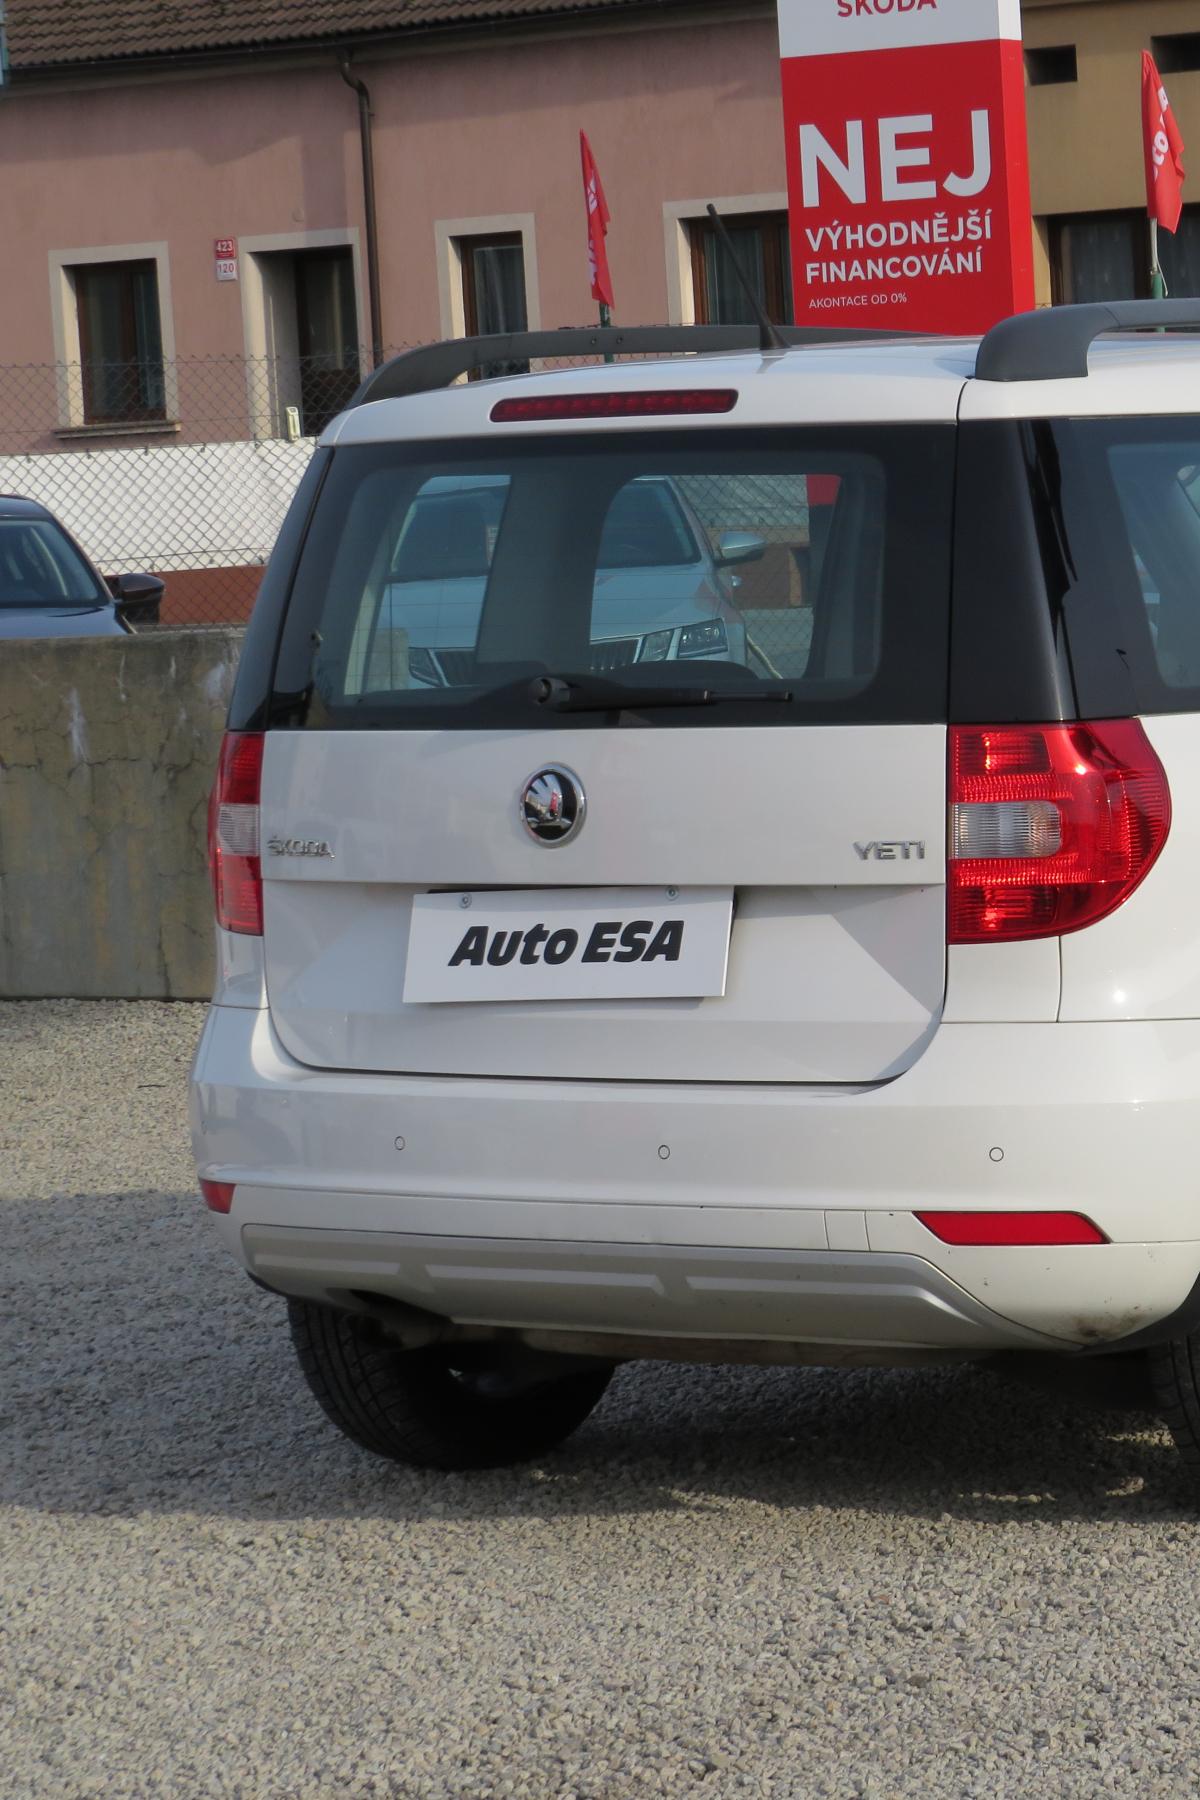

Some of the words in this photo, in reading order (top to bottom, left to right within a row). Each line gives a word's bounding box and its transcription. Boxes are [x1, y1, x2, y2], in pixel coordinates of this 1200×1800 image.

[799, 109, 992, 208] NEJ
[805, 208, 992, 252] VÝHODNĚJŠÍ
[216, 240, 233, 252] 423
[216, 262, 235, 273] 120
[805, 246, 983, 285] FINANCOVÁNÍ
[808, 295, 868, 309] AKONTACE
[871, 294, 888, 305] OD
[890, 292, 907, 304] 0%
[853, 840, 925, 860] YETI
[448, 923, 578, 966] Auto
[581, 920, 684, 963] ESA
